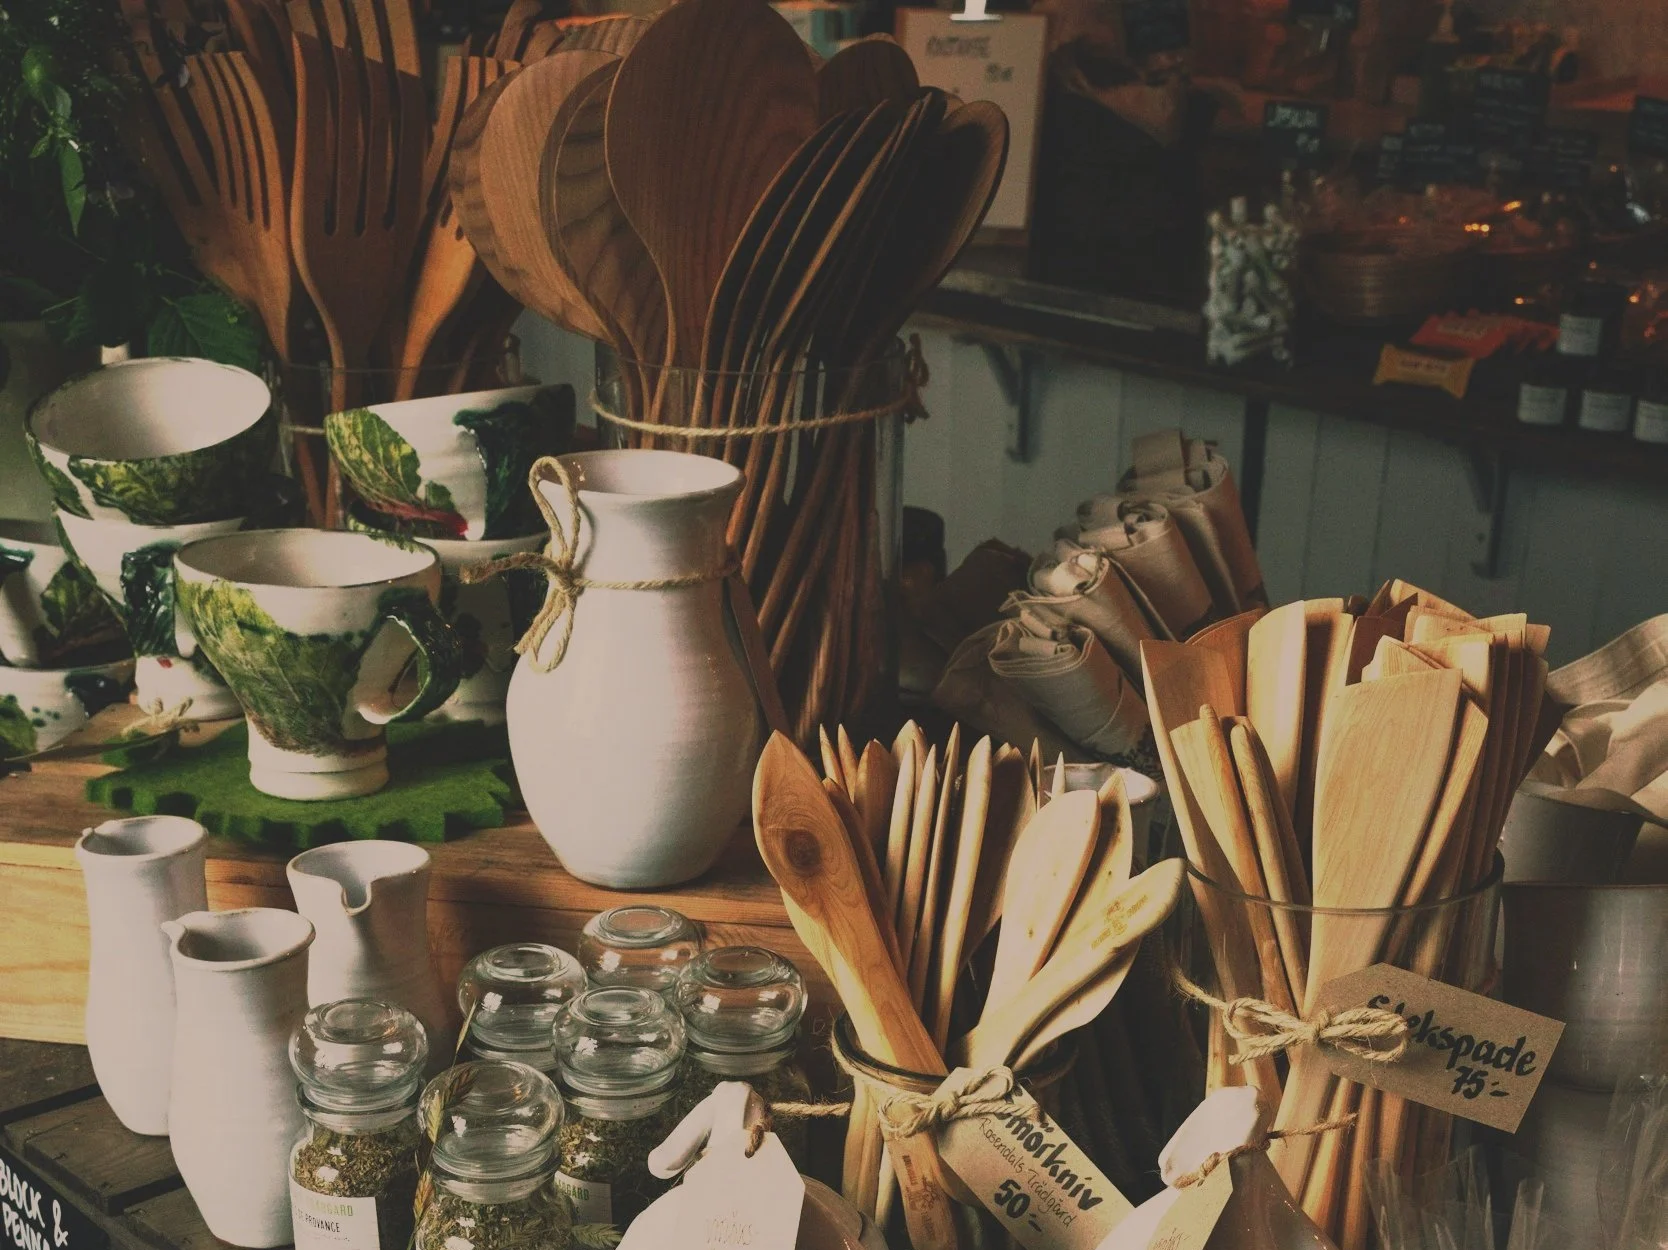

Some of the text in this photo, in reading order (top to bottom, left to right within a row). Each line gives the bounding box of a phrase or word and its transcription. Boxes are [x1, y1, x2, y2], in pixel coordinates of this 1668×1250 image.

[1367, 994, 1537, 1076] ekspade
[0, 1158, 69, 1248] BLOCK &
[978, 1117, 1077, 1228] Rosendals Trädgård
